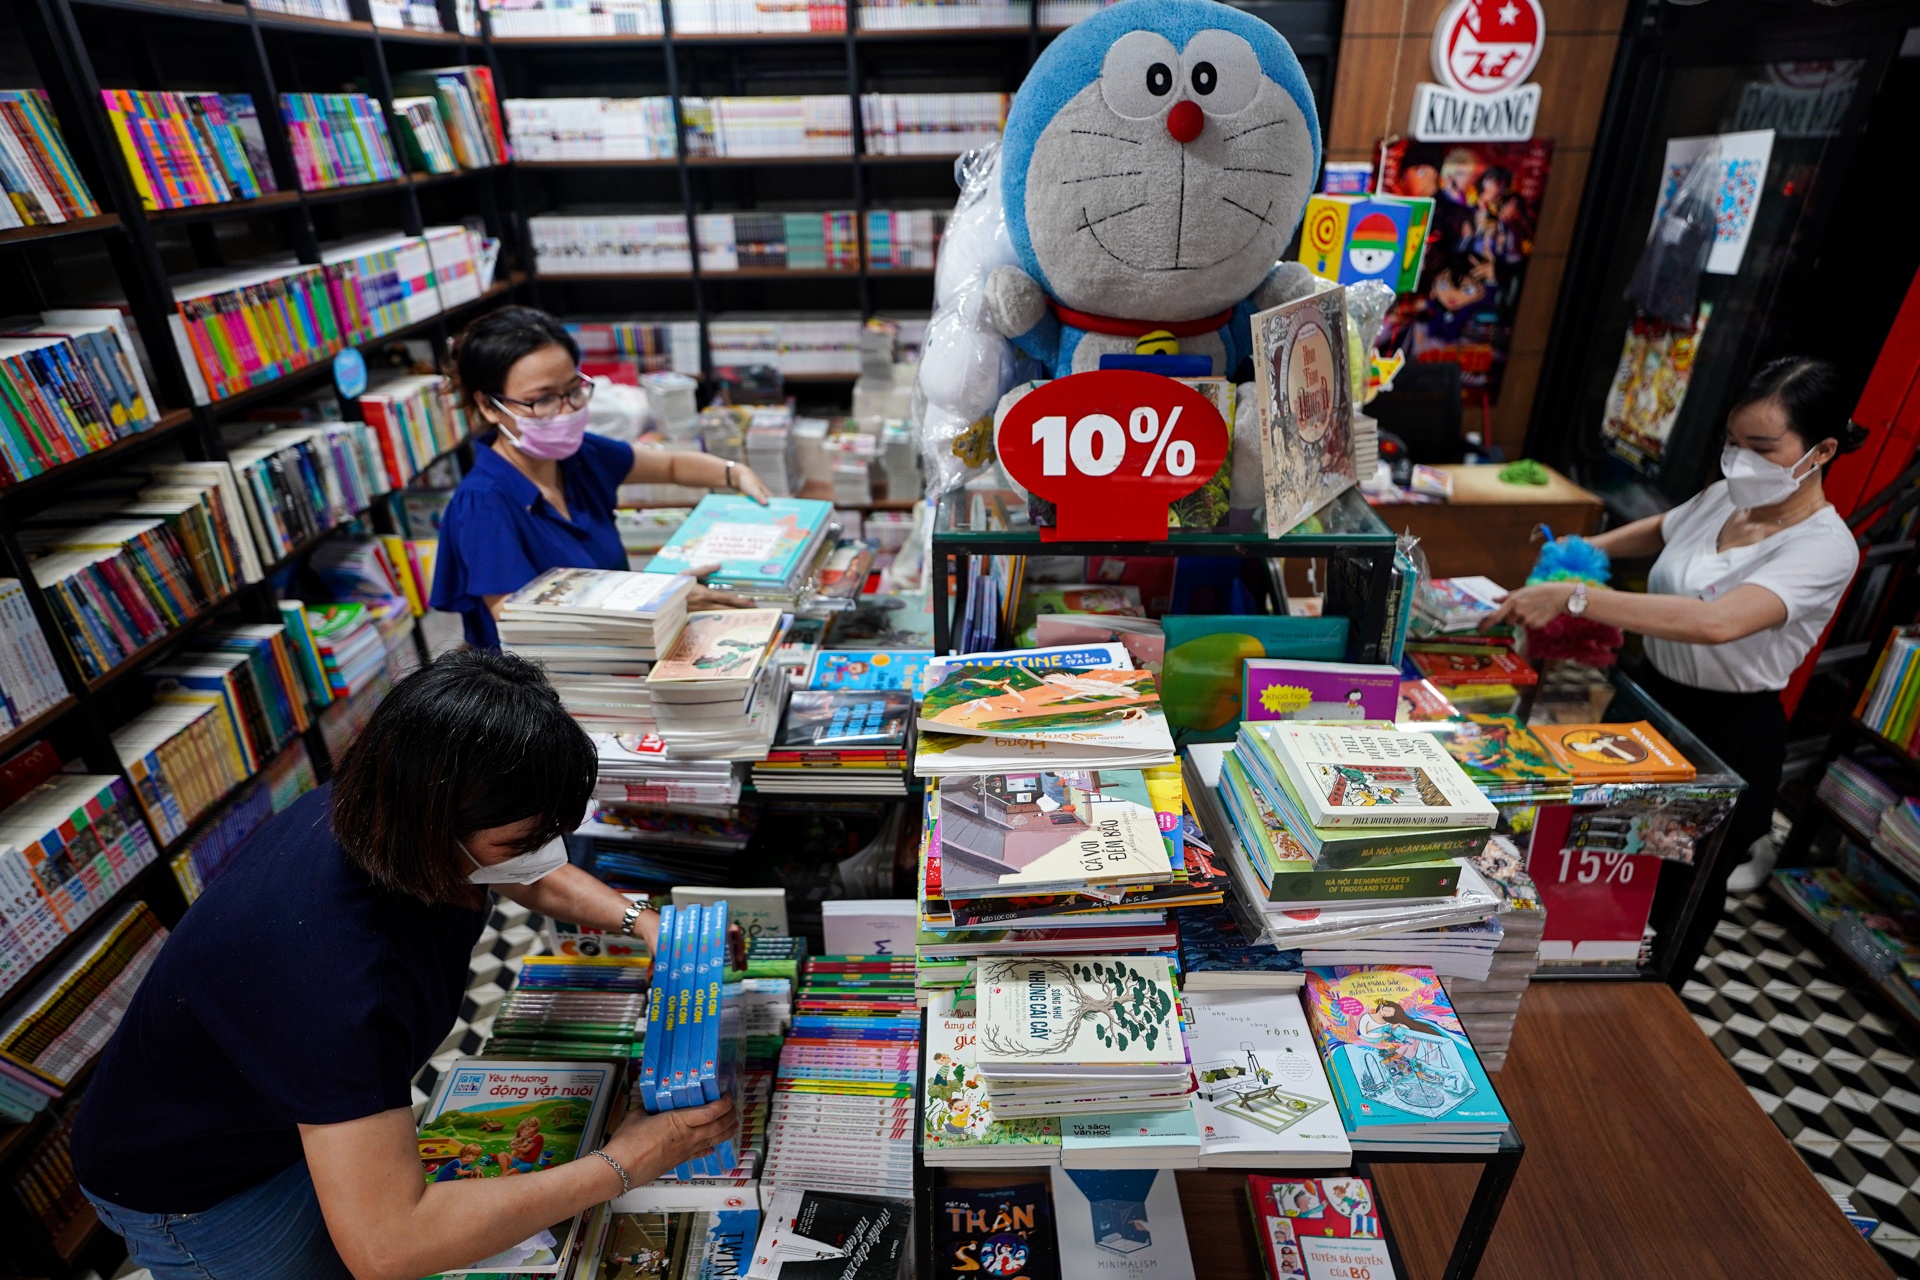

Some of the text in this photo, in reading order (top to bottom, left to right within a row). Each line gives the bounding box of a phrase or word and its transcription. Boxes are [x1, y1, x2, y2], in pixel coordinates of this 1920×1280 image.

[1425, 92, 1468, 135] KIM
[1032, 406, 1196, 477] 10%
[1266, 692, 1307, 702] Khoa học
[1278, 700, 1300, 709] trong
[1412, 738, 1440, 762] QUỐC
[1080, 840, 1104, 872] CÁ VOI
[1102, 838, 1127, 862] ĐÊM
[1361, 848, 1374, 857] HÀ
[1376, 846, 1392, 856] NỘI
[1394, 844, 1419, 855] NGÀN
[1420, 842, 1442, 853] NĂM
[1558, 851, 1634, 884] 15%
[1325, 876, 1410, 886] HÀ NỘI REMINISCENCES
[1340, 884, 1379, 892] THOUSAND
[1381, 883, 1404, 892] YEARS
[650, 986, 662, 1022] CÚN CON
[678, 989, 690, 1025] CÚN CON
[693, 988, 705, 1024] CÚN CON
[708, 981, 719, 1016] CÚN CON
[1028, 970, 1052, 1040] NHỮNG CÁI CÂY
[1052, 989, 1064, 1020] SỐNG NHƯ
[666, 1014, 676, 1031] CON
[1266, 1028, 1300, 1037] rộng
[488, 1074, 548, 1086] Yêu thương
[490, 1085, 529, 1098] động
[534, 1086, 558, 1098] vật
[562, 1086, 593, 1096] nuôi
[714, 1230, 744, 1280] TWIN
[1098, 1260, 1157, 1269] MINIMALISM
[1310, 1252, 1338, 1263] TUYÊN
[1340, 1253, 1352, 1263] BỐ
[1330, 1266, 1370, 1280] CỦA BỐ
